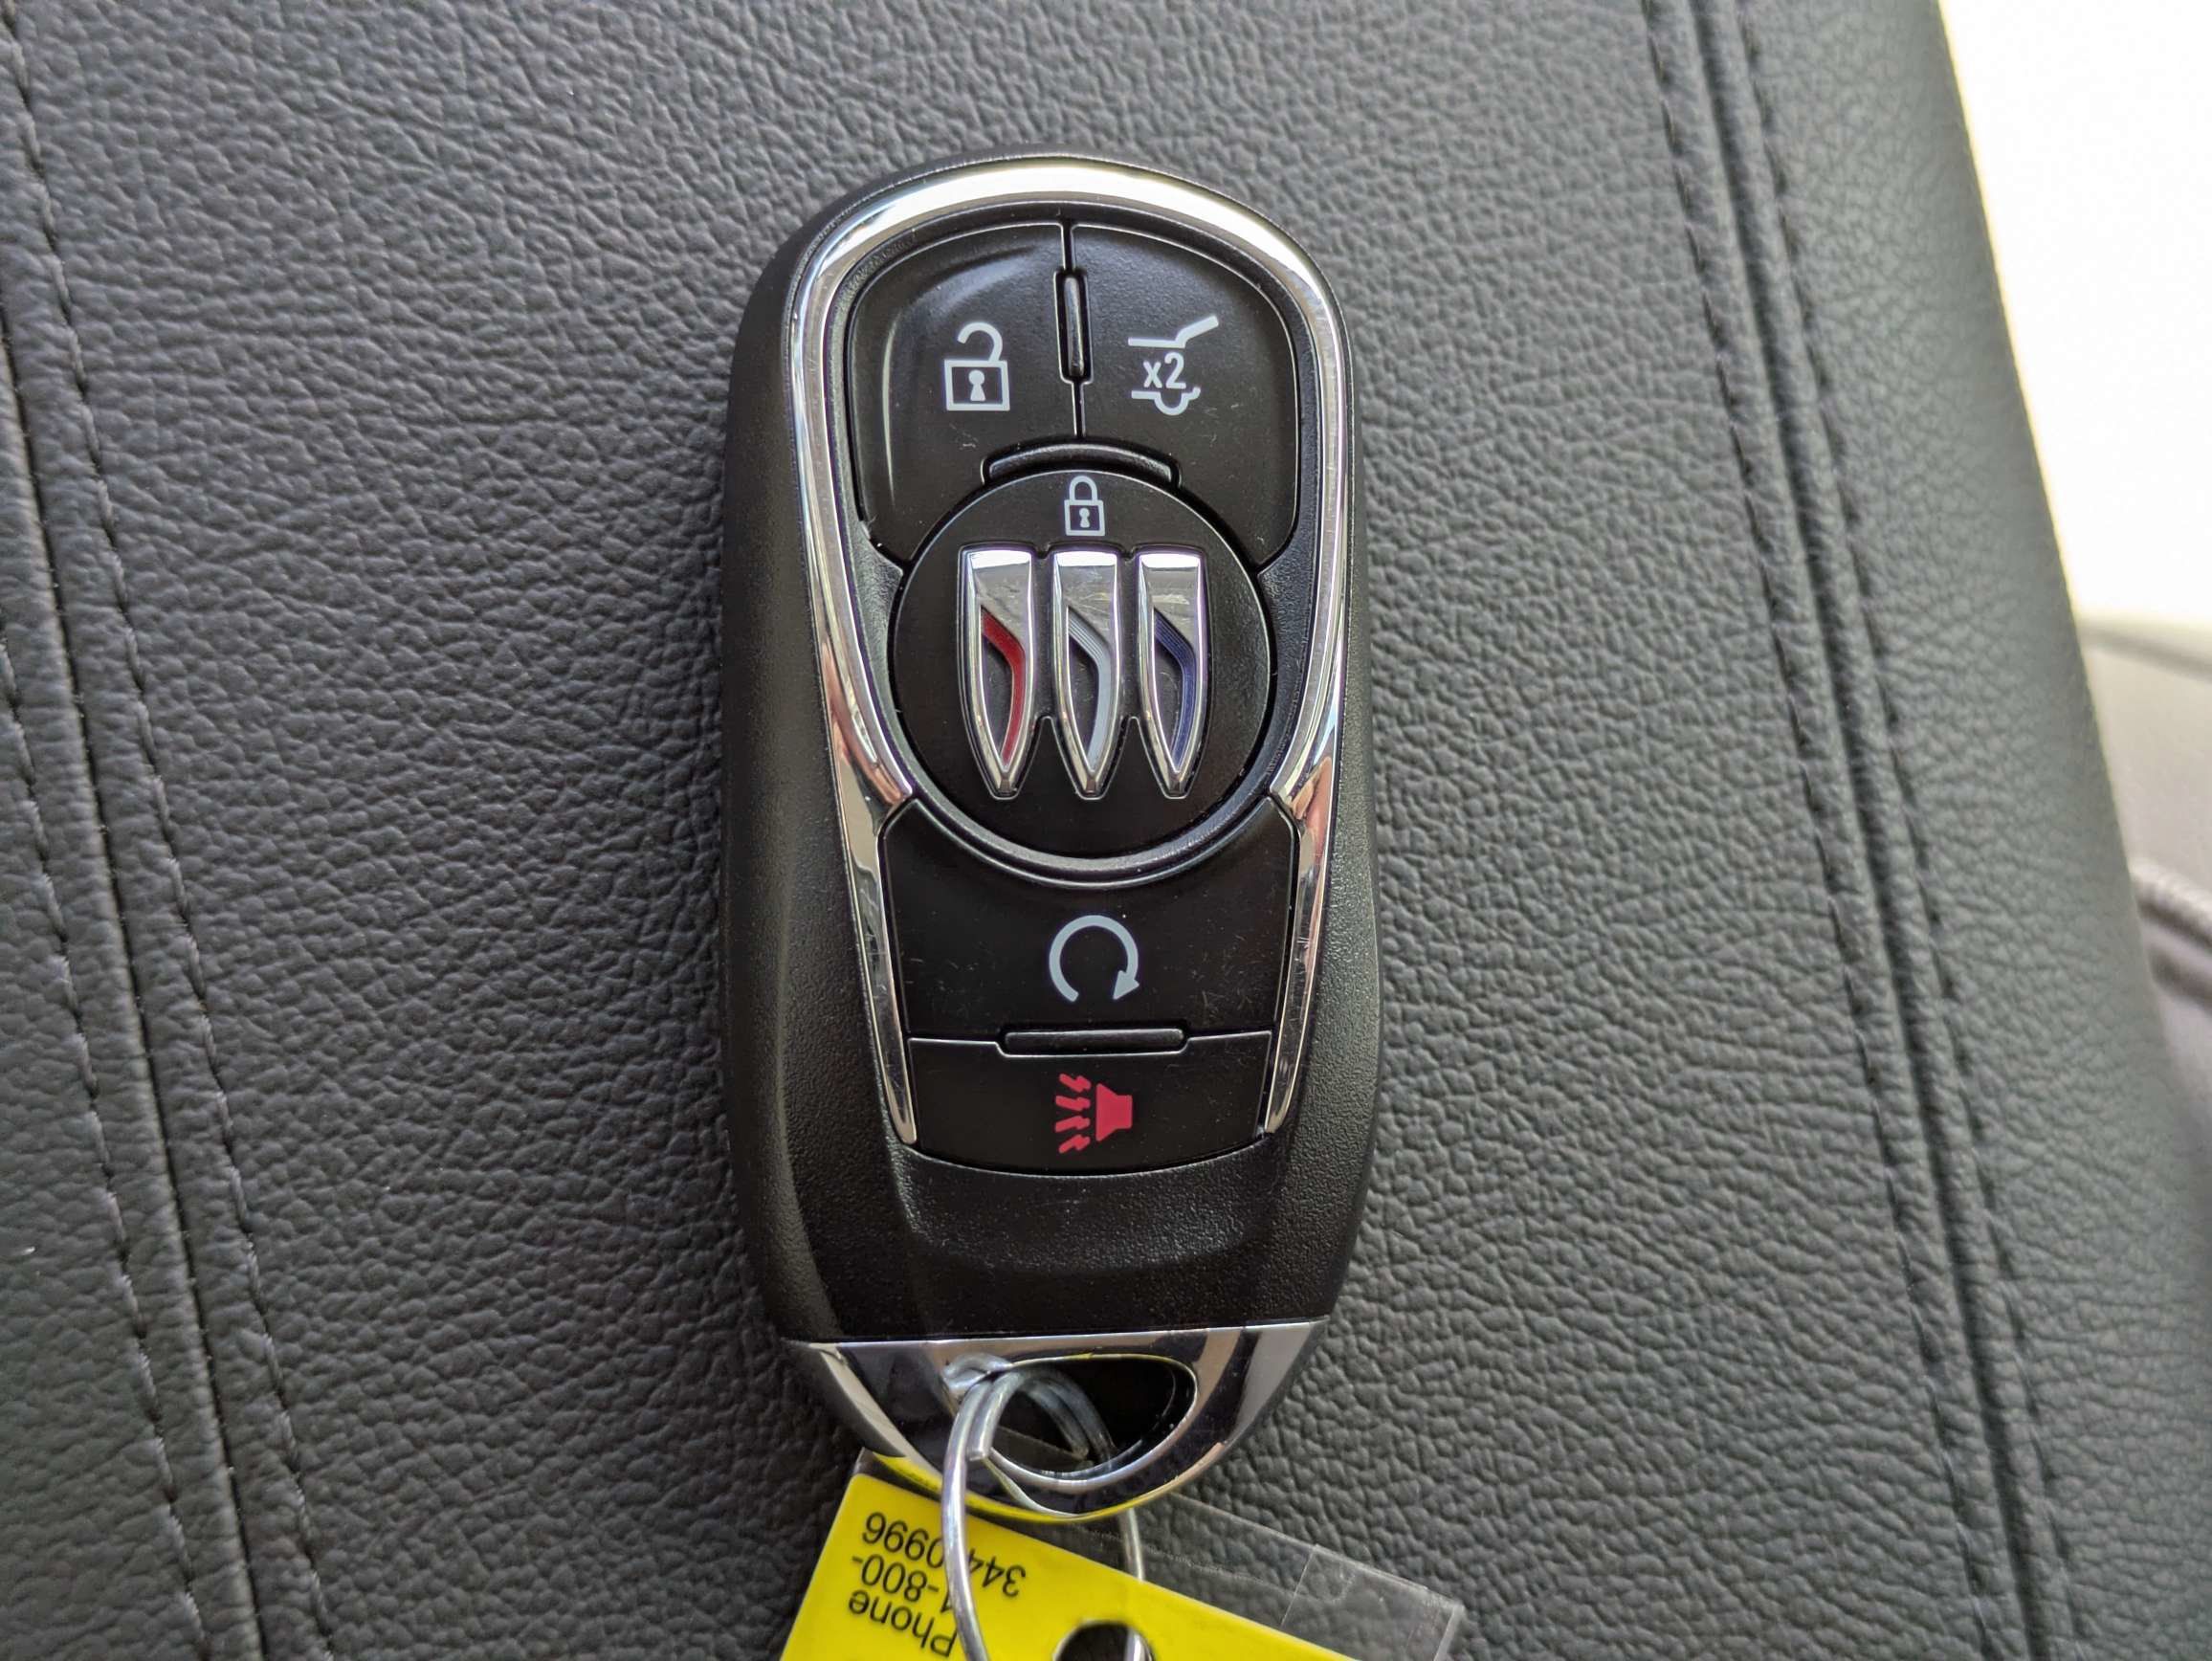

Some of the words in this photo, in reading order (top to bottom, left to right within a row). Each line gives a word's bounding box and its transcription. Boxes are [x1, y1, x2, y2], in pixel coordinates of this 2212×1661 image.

[1142, 351, 1186, 389] x2
[852, 1554, 954, 1614] 1-800-
[848, 1589, 958, 1658] Phone
